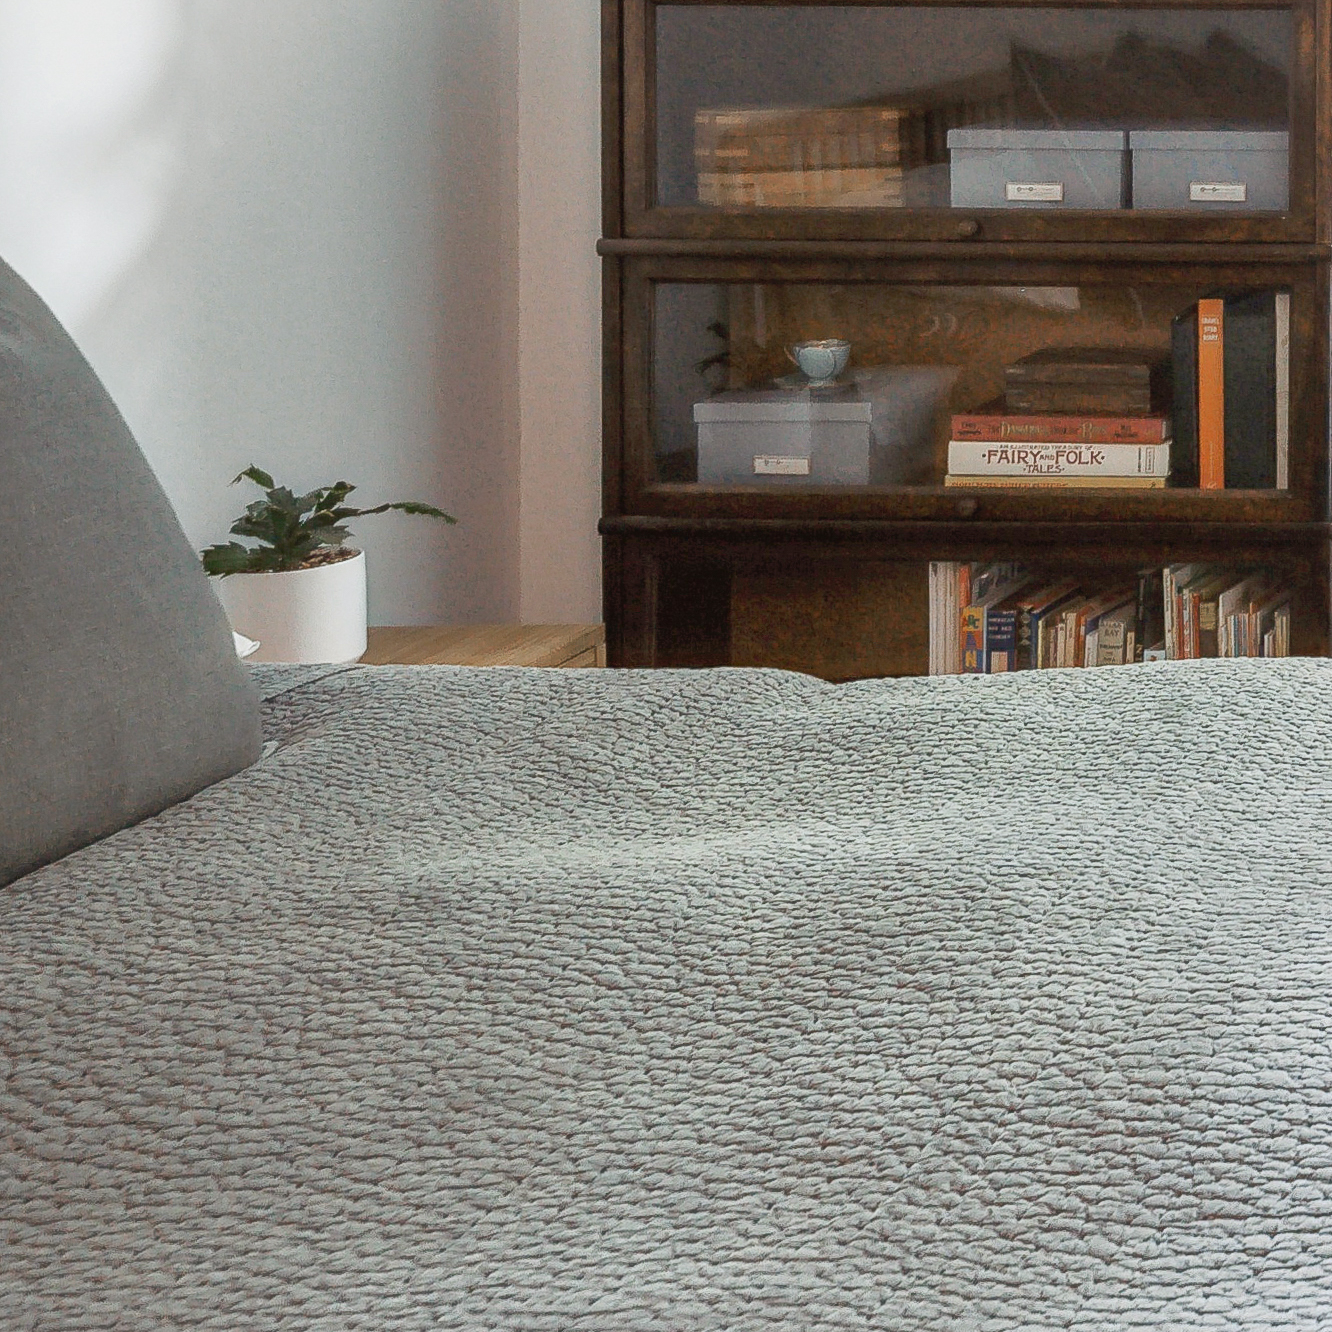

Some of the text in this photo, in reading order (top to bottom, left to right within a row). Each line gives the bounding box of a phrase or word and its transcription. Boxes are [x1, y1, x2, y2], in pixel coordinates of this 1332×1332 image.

[987, 449, 1042, 465] FAIRY
[1055, 450, 1103, 465] FOLK
[1026, 464, 1062, 474] TALES
